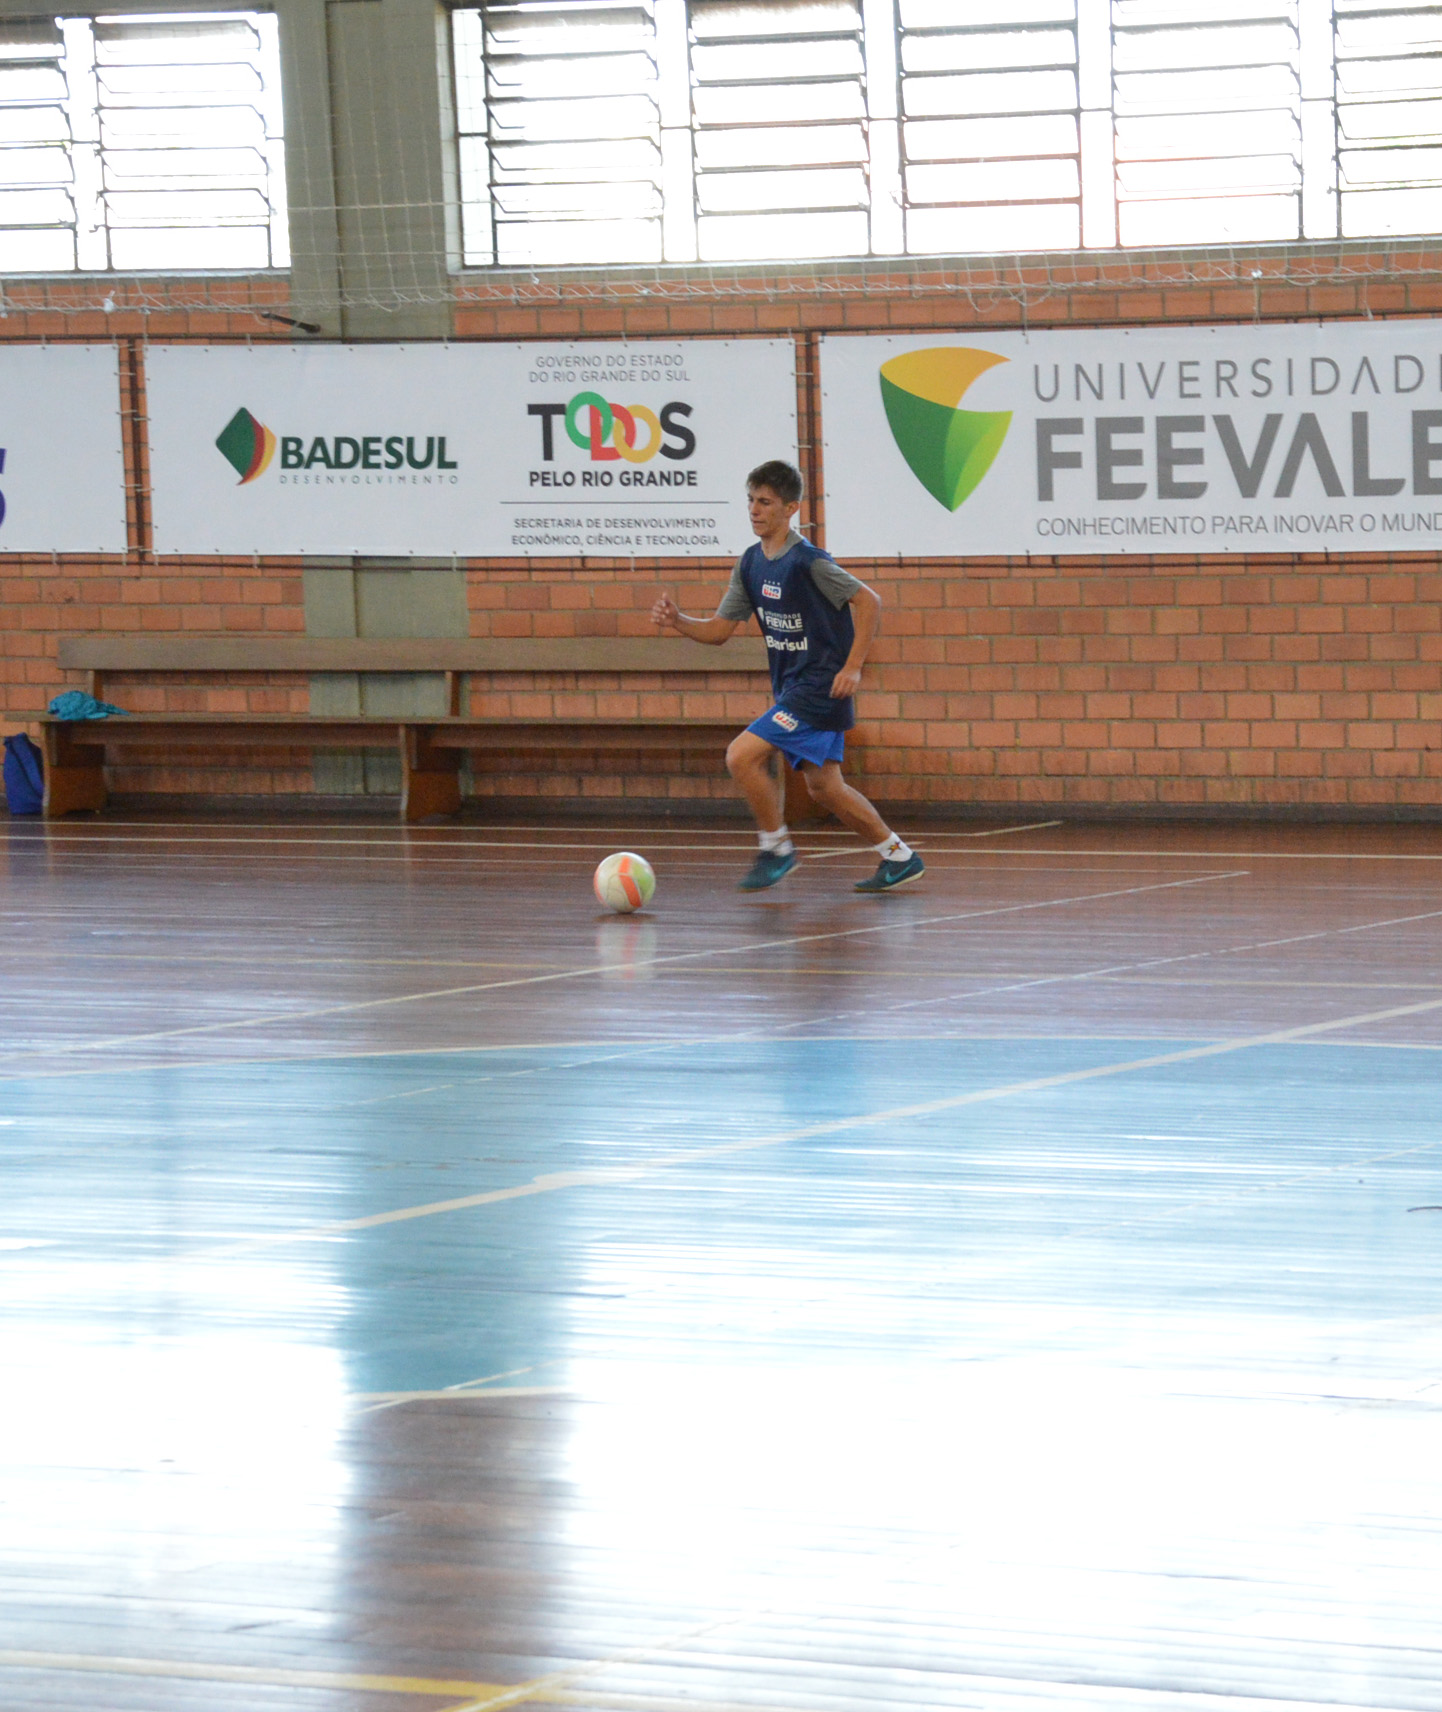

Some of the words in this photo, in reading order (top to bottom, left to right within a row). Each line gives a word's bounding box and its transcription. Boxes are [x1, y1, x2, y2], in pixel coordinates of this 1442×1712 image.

[535, 355, 602, 368] GOVERNO
[605, 354, 627, 368] DO
[630, 353, 684, 367] ESTADO
[529, 371, 549, 383] DO
[552, 370, 577, 383] RIO
[580, 370, 637, 383] GRANDE
[641, 369, 662, 382] DO
[665, 369, 692, 382] SUL
[527, 391, 696, 464] TODOS
[280, 435, 458, 470] BADESUL
[279, 474, 459, 486] DESENVOLVIMENTO
[528, 470, 576, 487] PELO
[581, 470, 614, 487] RIO
[618, 470, 698, 487] GRANDE
[514, 517, 584, 529] SECRETARIA
[586, 517, 602, 529] DE
[604, 517, 717, 529] DESENVOLVIMENTO
[1036, 515, 1206, 537] CONHECIMENTO
[1211, 514, 1269, 535] PARA
[1273, 513, 1354, 534] INOVAR
[1359, 513, 1377, 533] O
[511, 532, 584, 547] ECONÔMICO,
[586, 532, 633, 546] CIÊNCIA
[635, 535, 643, 545] E
[646, 534, 720, 546] TECNOLOGIA
